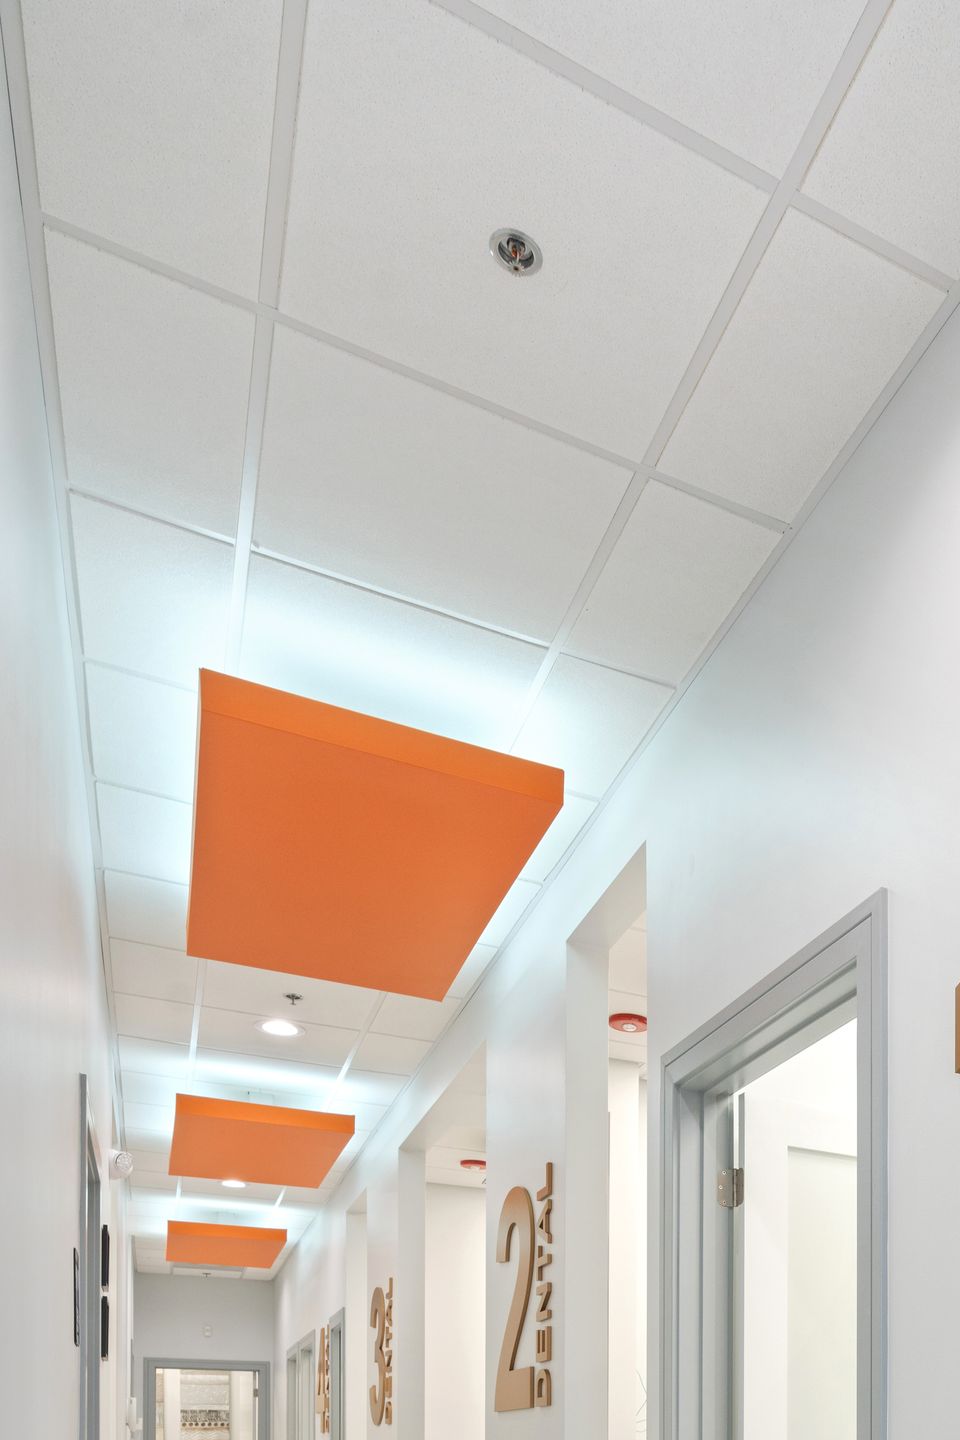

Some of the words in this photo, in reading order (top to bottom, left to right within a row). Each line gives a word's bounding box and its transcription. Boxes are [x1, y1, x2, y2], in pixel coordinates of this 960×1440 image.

[369, 1286, 385, 1426] 3
[385, 1277, 393, 1425] DENTAL
[495, 1186, 534, 1412] 2
[536, 1162, 553, 1408] DENTAL
